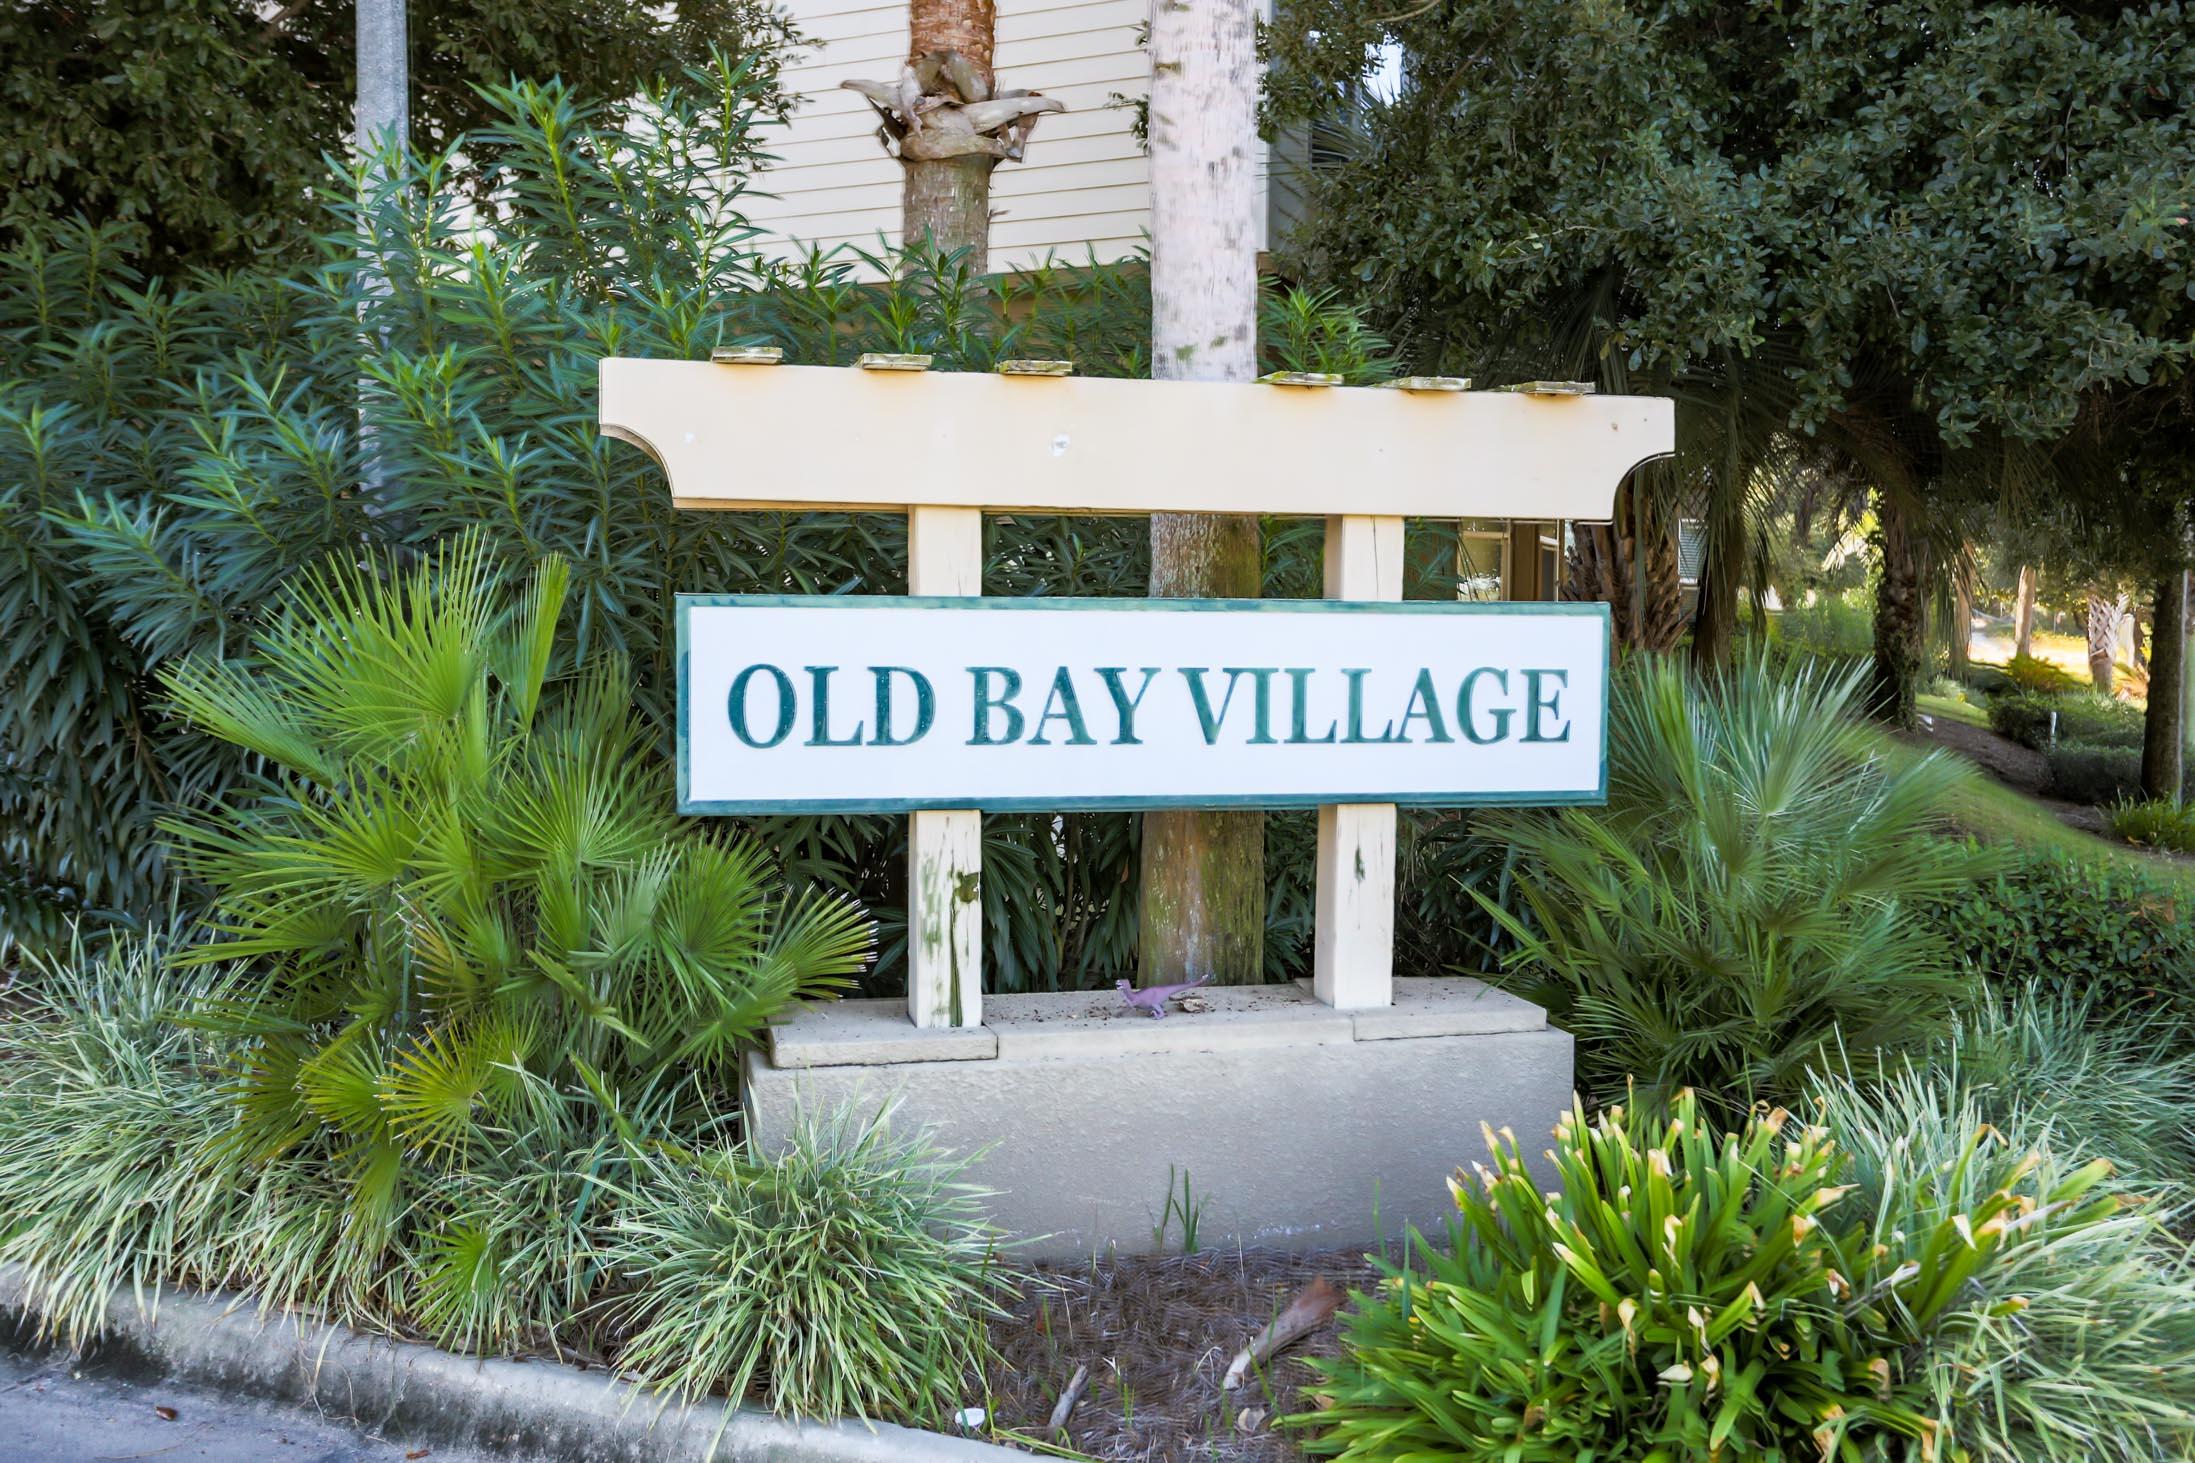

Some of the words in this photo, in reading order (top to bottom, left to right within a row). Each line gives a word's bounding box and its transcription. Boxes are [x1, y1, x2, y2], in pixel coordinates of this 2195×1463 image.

[727, 663, 935, 748] OLD
[965, 665, 1160, 746] BAY
[1177, 666, 1571, 746] VILLAGE
